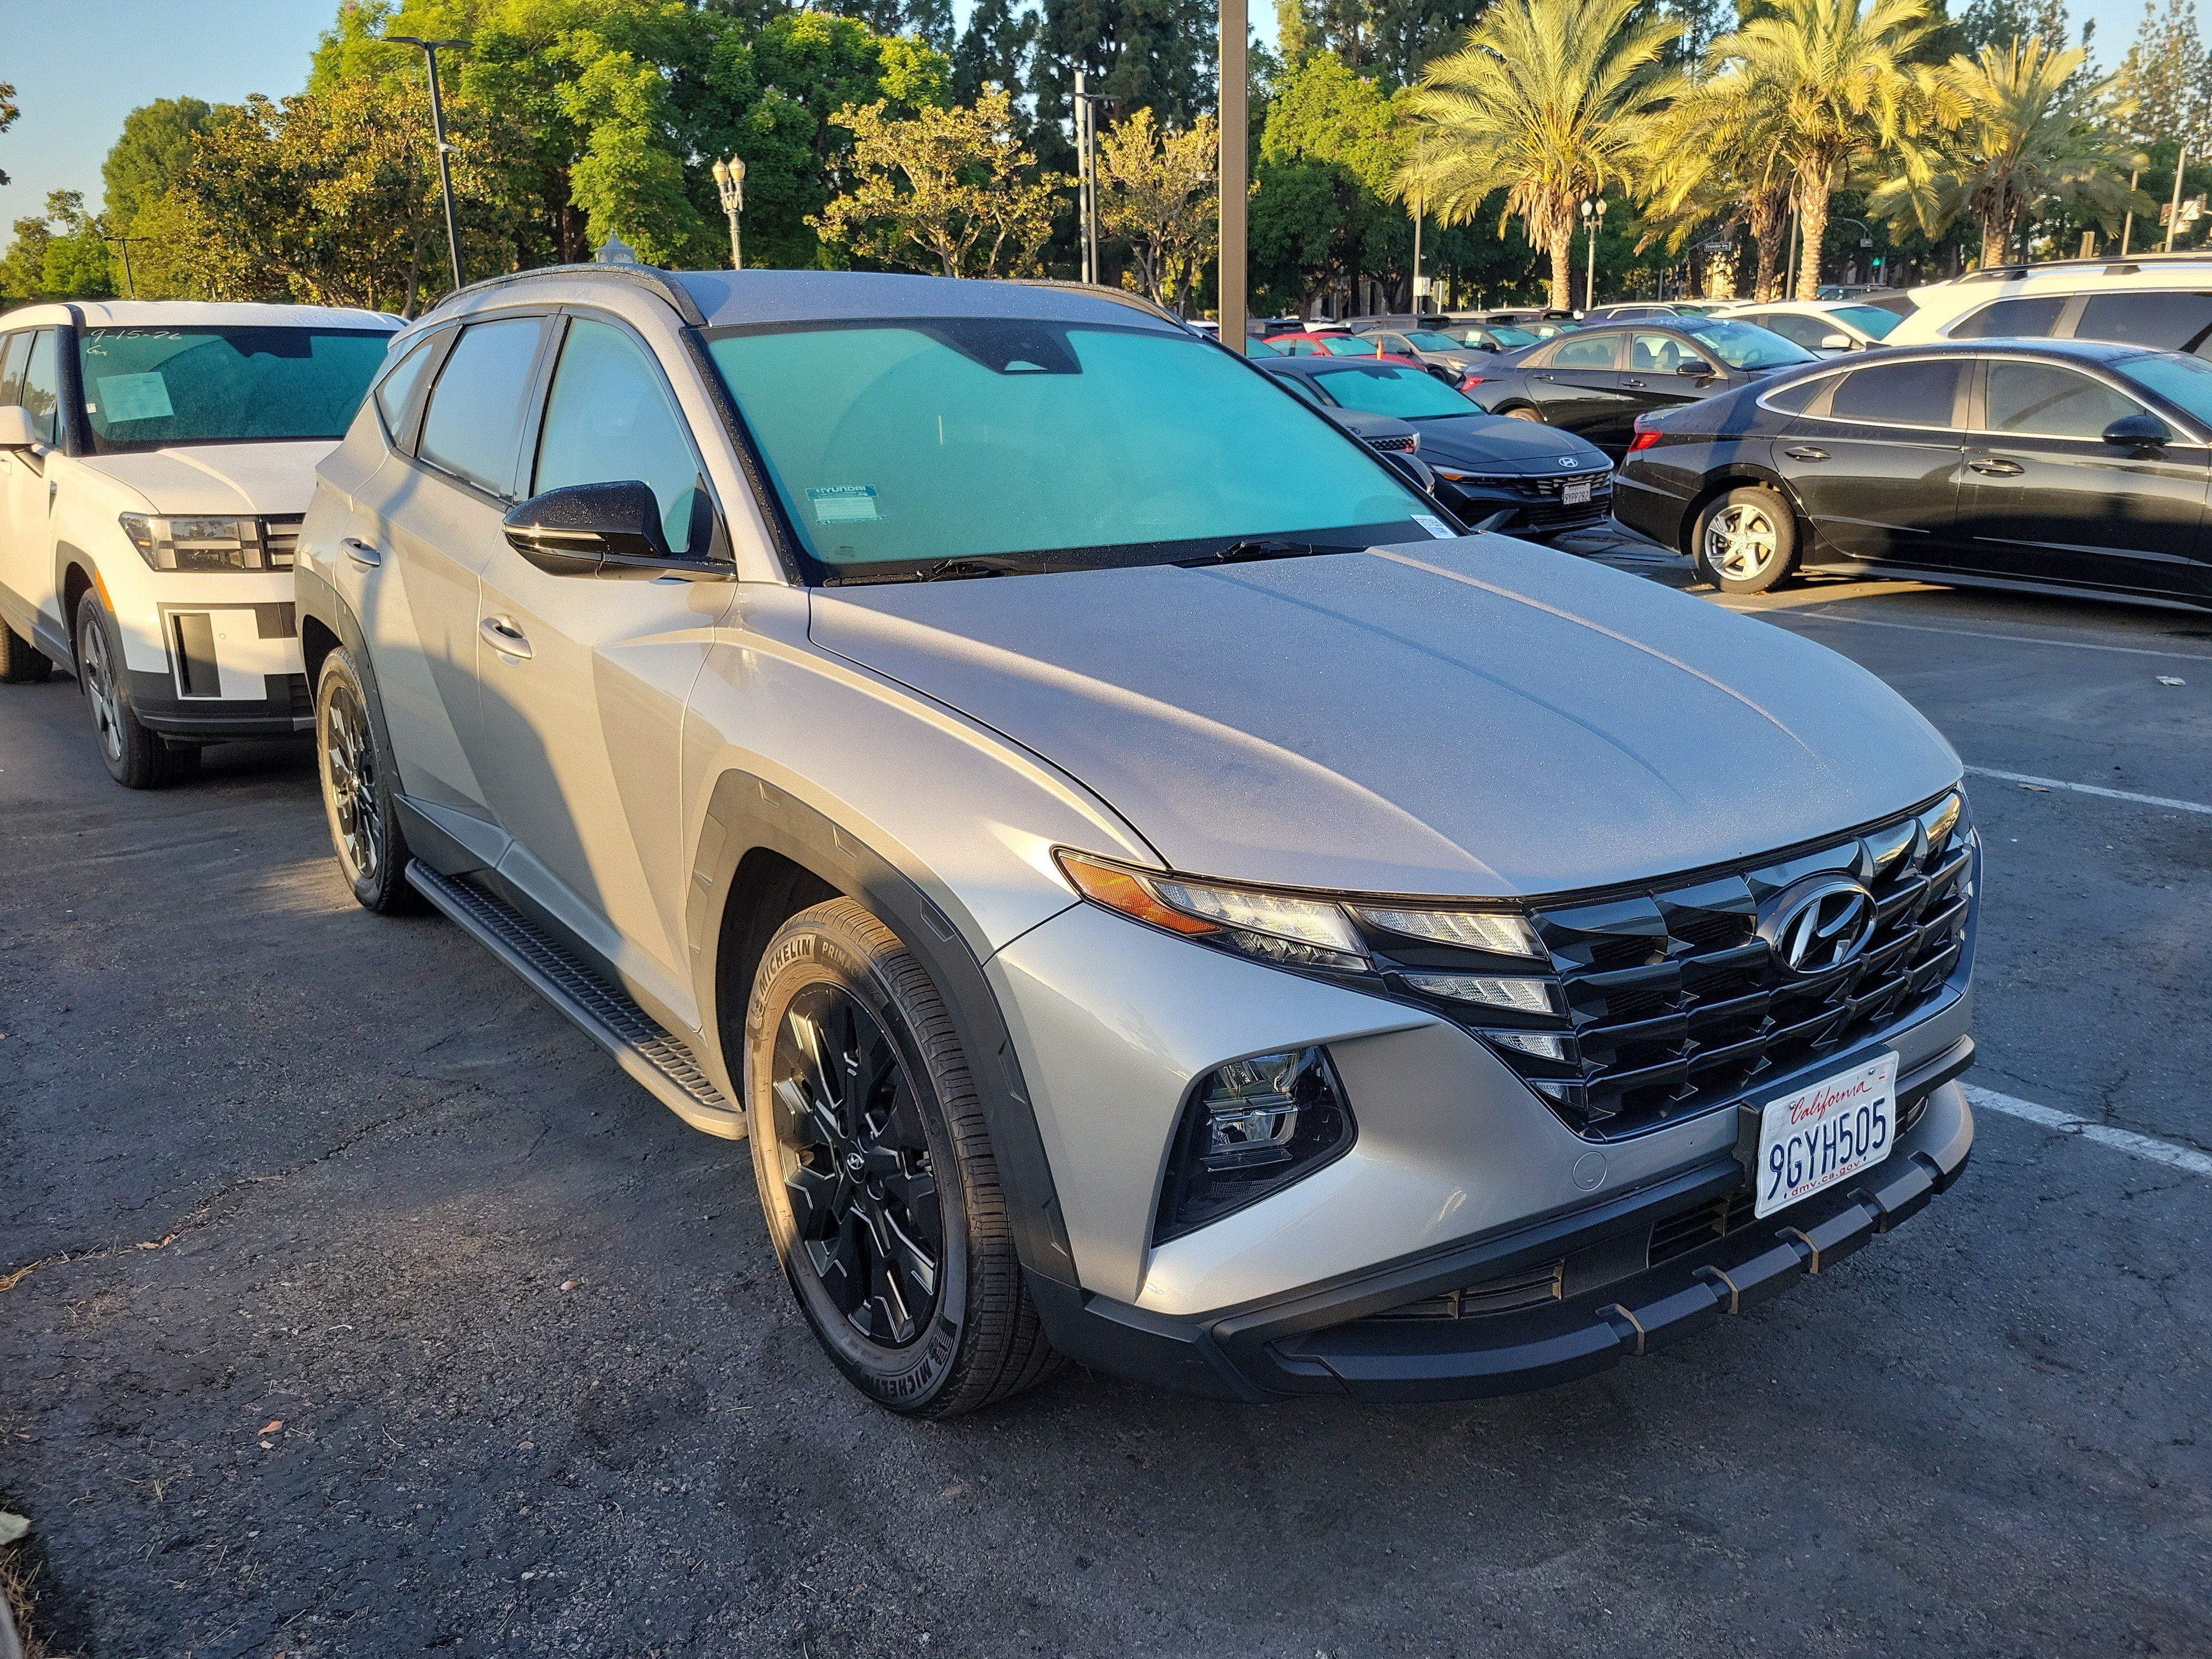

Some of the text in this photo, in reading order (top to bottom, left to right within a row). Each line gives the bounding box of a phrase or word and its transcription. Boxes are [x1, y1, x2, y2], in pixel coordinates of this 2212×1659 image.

[90, 329, 182, 343] 9-15-26
[759, 939, 811, 997] MICHELIN
[1791, 1076, 1872, 1125] California
[1768, 1096, 1886, 1200] 9GYH505
[1791, 1160, 1860, 1197] dmv.ca.gov
